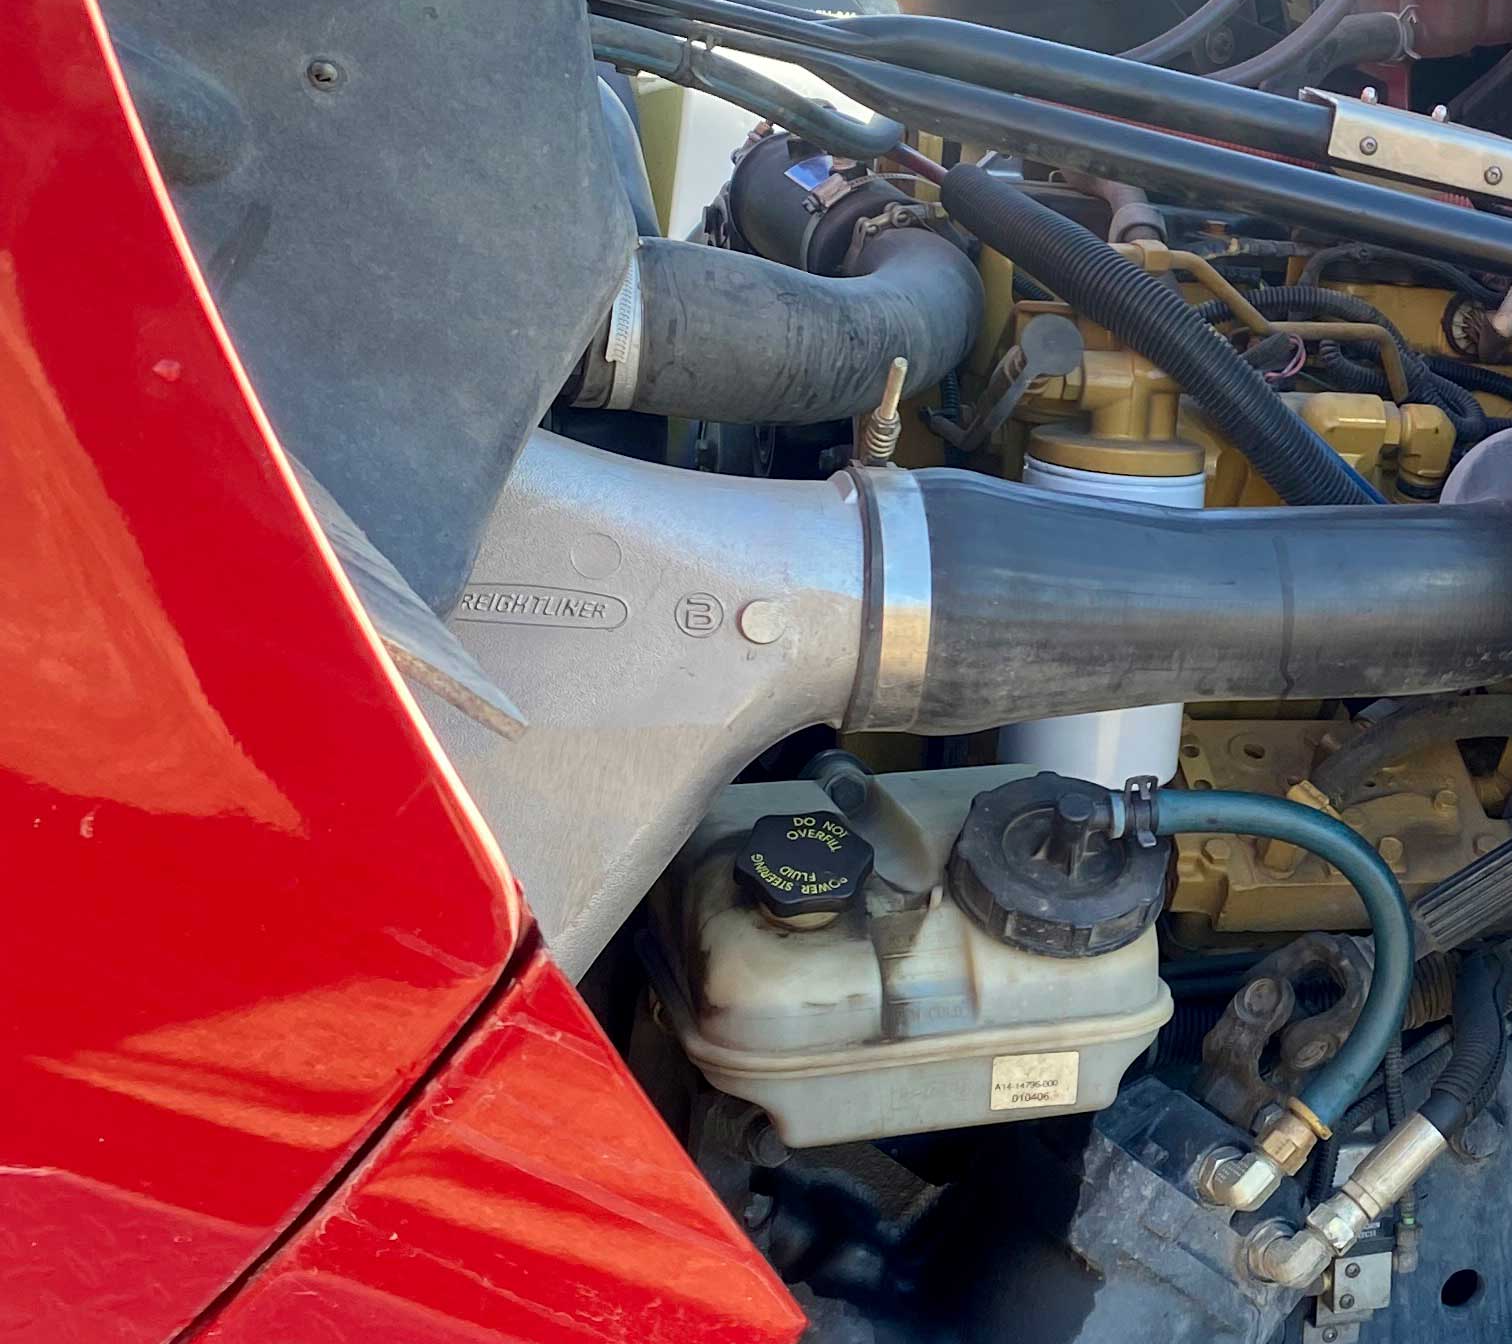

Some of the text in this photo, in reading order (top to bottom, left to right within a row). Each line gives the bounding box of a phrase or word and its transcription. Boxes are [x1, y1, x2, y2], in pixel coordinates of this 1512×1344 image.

[461, 592, 608, 619] REIGHTLINER
[786, 828, 843, 853] OVERFILL
[792, 817, 849, 839] DO NOT
[750, 853, 849, 895] POWER STEERING
[779, 865, 817, 882] FLUID
